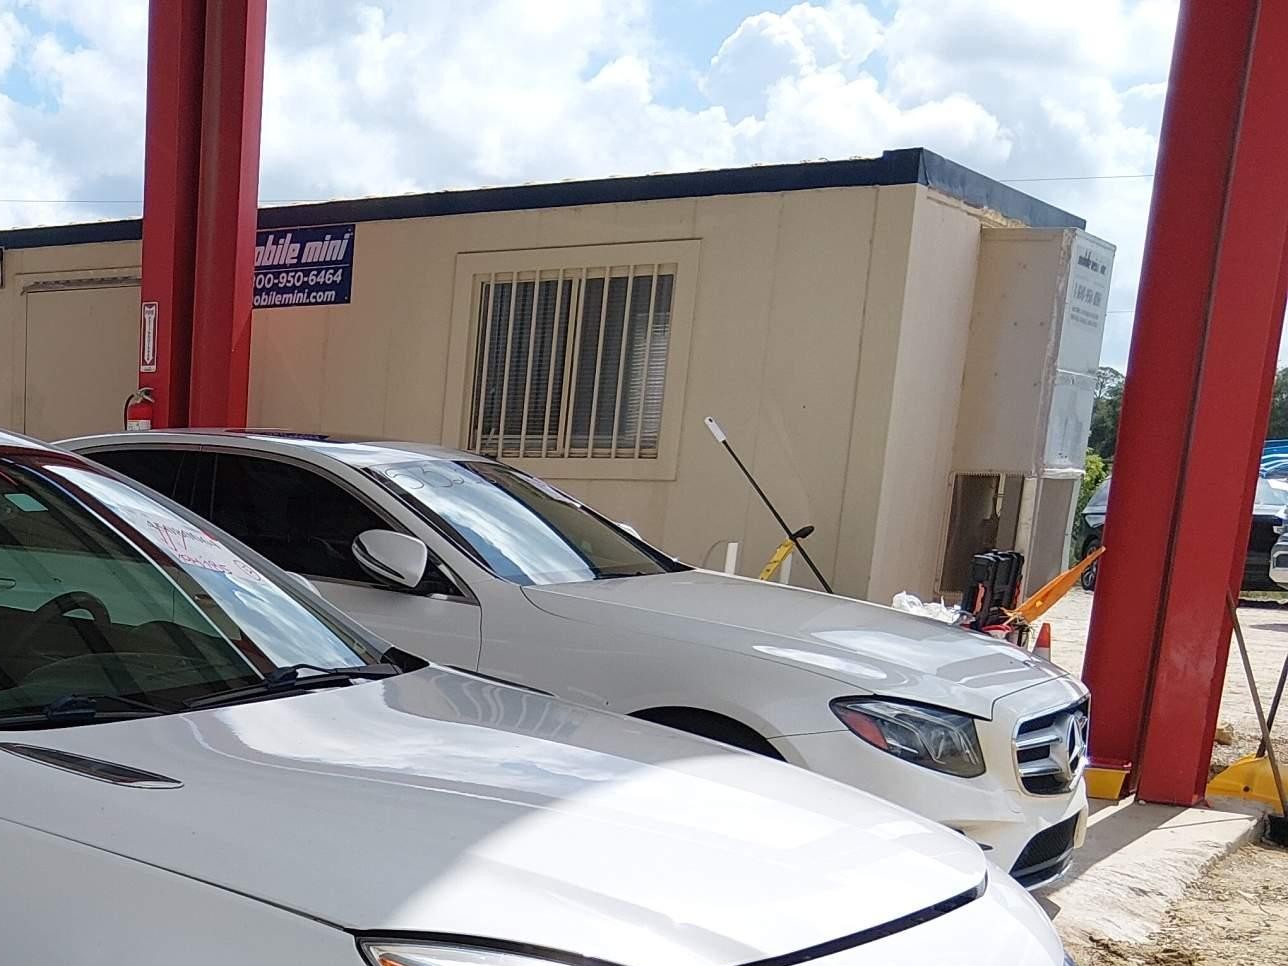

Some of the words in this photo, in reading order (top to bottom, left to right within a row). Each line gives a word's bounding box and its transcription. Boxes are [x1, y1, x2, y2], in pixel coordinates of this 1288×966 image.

[255, 233, 300, 266] obile
[301, 234, 350, 263] mini
[254, 269, 343, 289] 00-950-6464
[254, 290, 336, 306] obilemini.com
